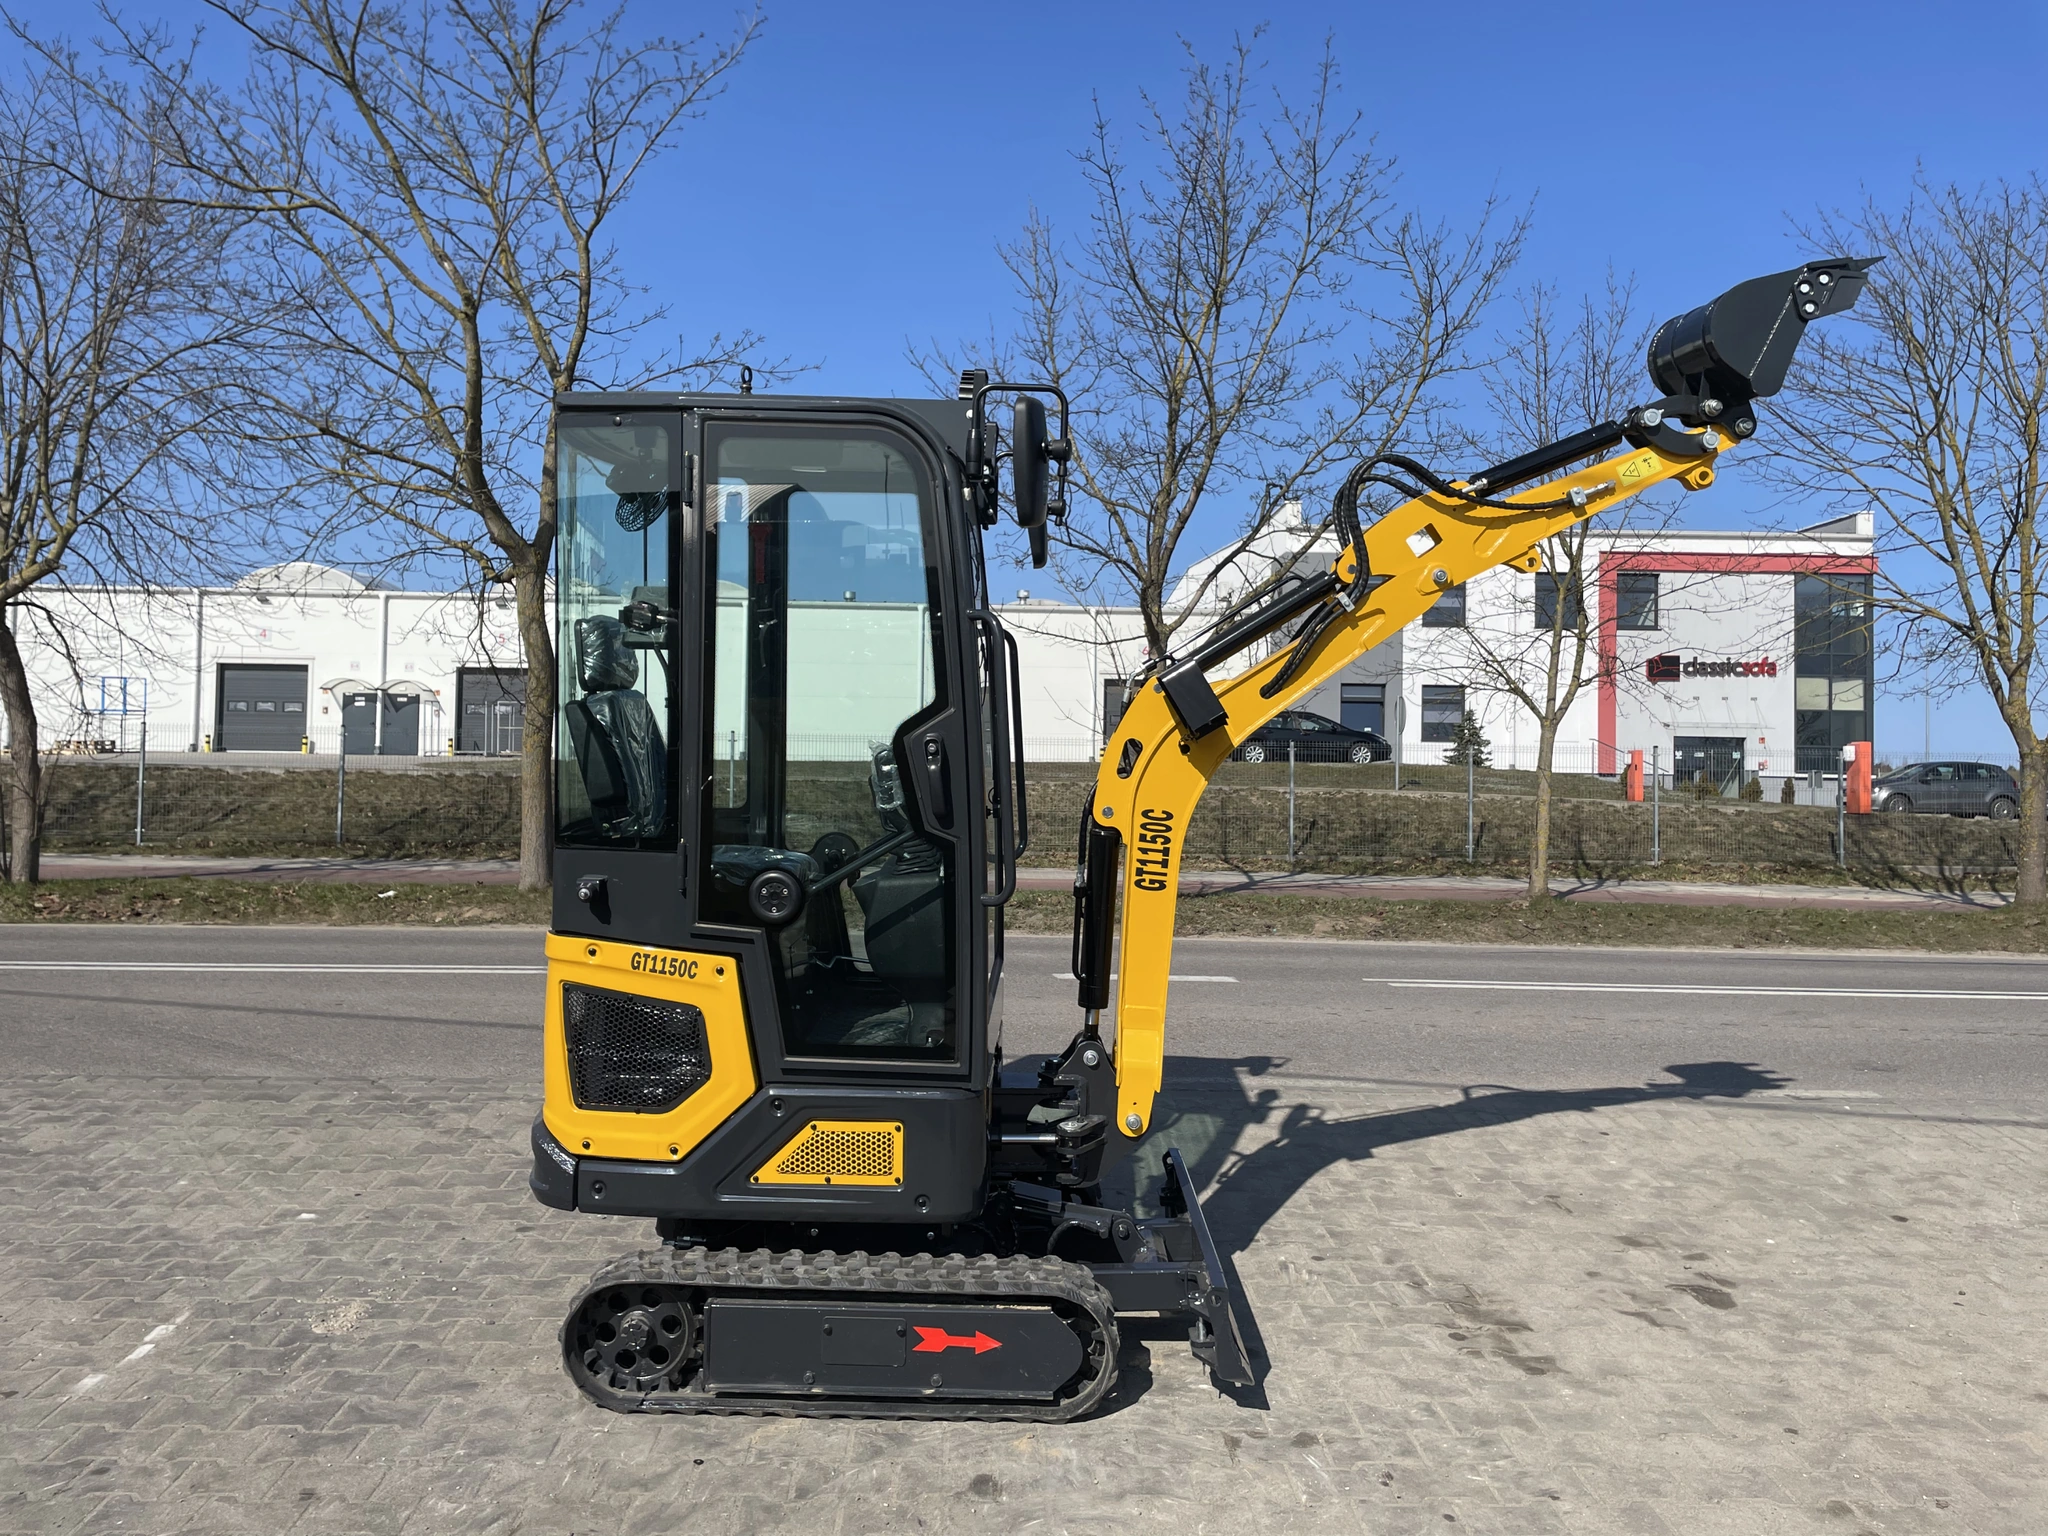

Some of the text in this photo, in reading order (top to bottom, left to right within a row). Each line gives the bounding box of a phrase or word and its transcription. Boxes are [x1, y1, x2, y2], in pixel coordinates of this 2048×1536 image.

[260, 629, 267, 639] 4
[499, 634, 506, 644] 5
[1142, 646, 1150, 656] 6
[1683, 656, 1777, 677] classicsofa
[1134, 809, 1174, 891] GT1150C
[631, 952, 698, 979] GT1150C
